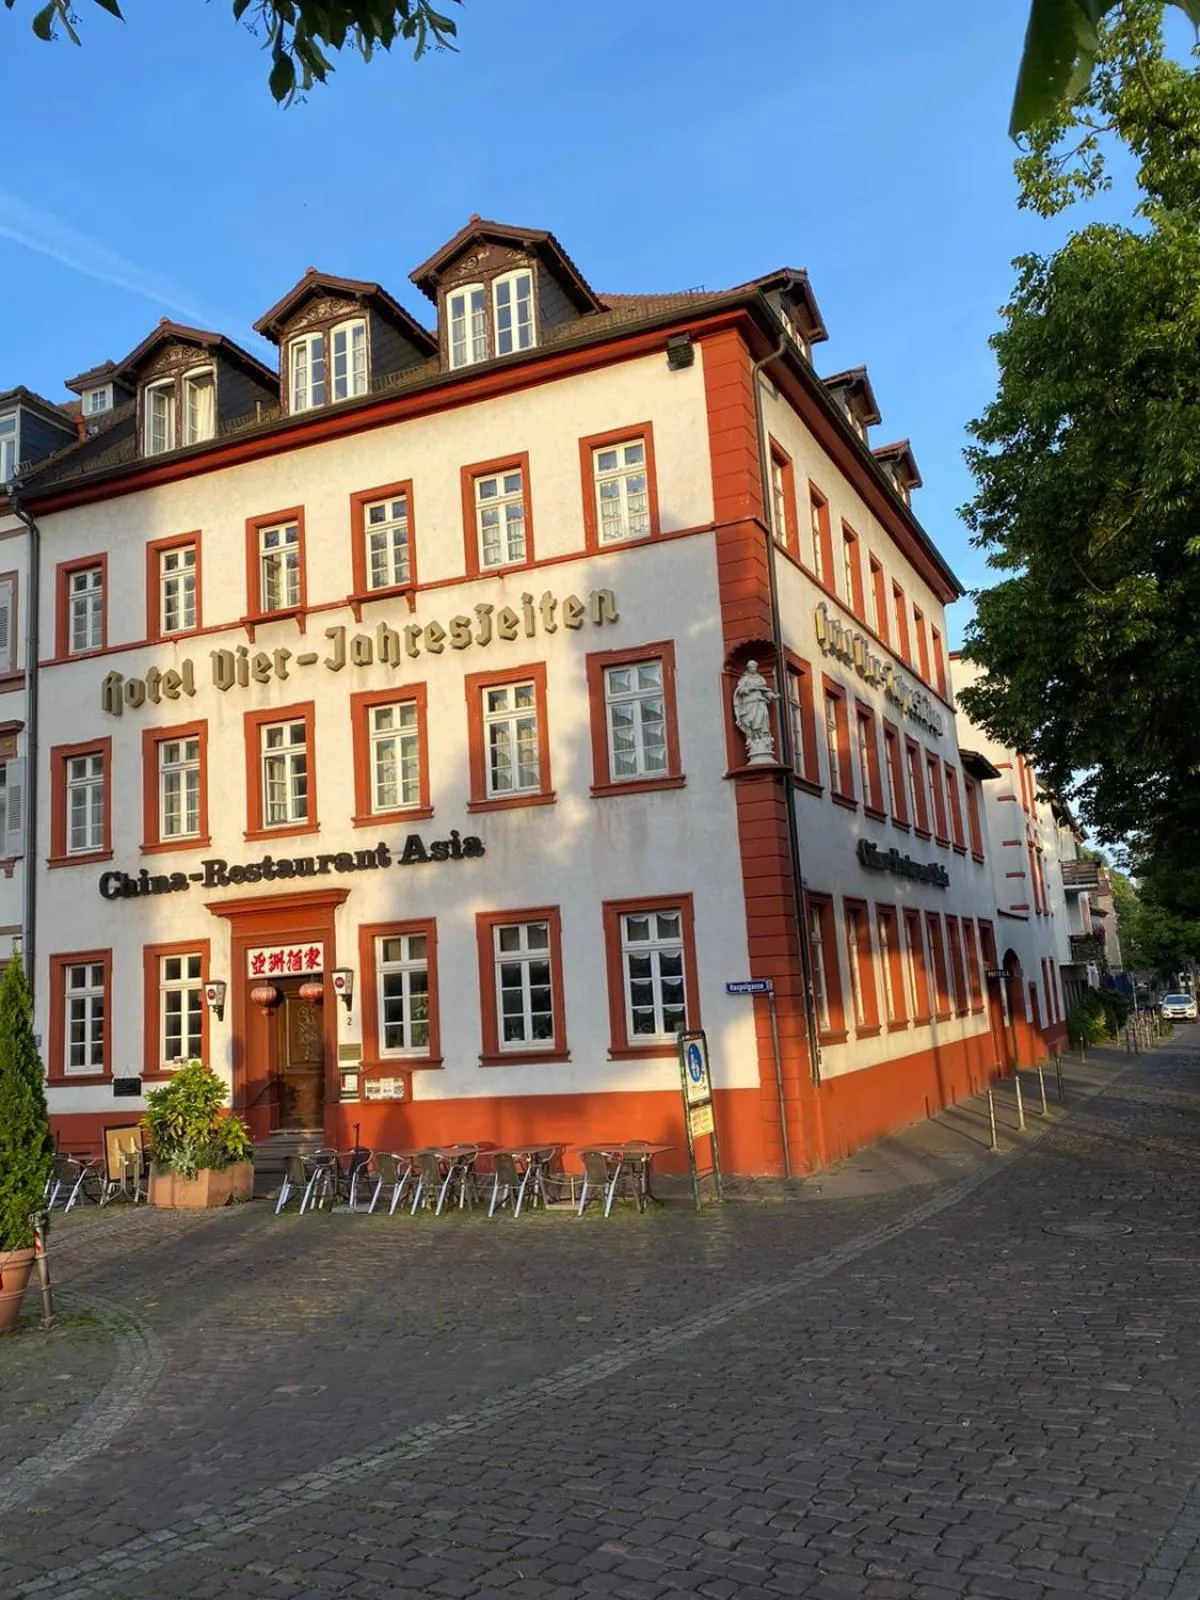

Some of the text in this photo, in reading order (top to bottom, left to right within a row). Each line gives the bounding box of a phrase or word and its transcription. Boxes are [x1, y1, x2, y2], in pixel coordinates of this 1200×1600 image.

[101, 658, 196, 716] Hotel
[99, 829, 486, 901] China-Restaurant Asia
[347, 1017, 352, 1025] 2
